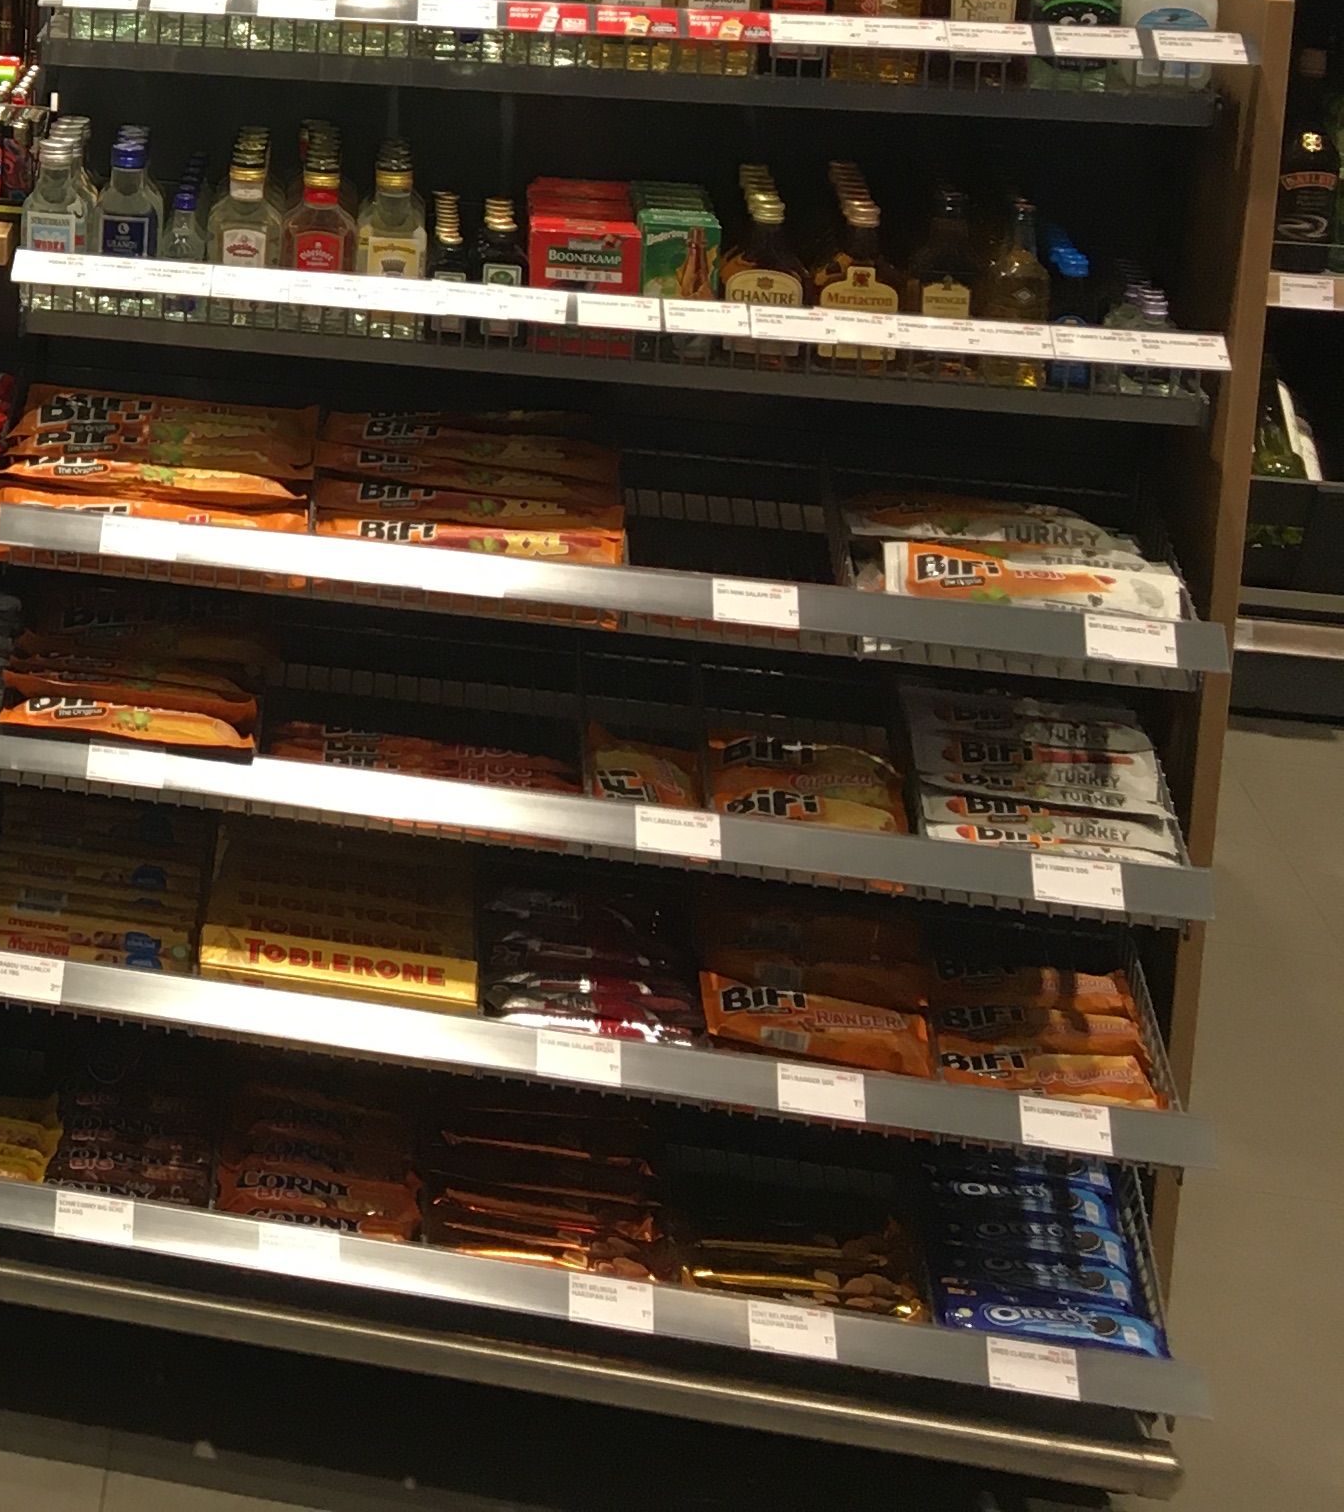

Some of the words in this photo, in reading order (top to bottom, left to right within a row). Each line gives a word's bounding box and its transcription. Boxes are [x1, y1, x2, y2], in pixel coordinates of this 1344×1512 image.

[548, 248, 621, 266] BOONEKAMP
[827, 292, 893, 307] Mariacron
[925, 296, 968, 305] SPRINGER
[504, 533, 569, 556] XXL
[1000, 524, 1101, 548] TURKEY
[1063, 821, 1130, 842] TURKEY
[244, 936, 446, 987] TOBLERONE
[816, 1009, 902, 1031] RANGER
